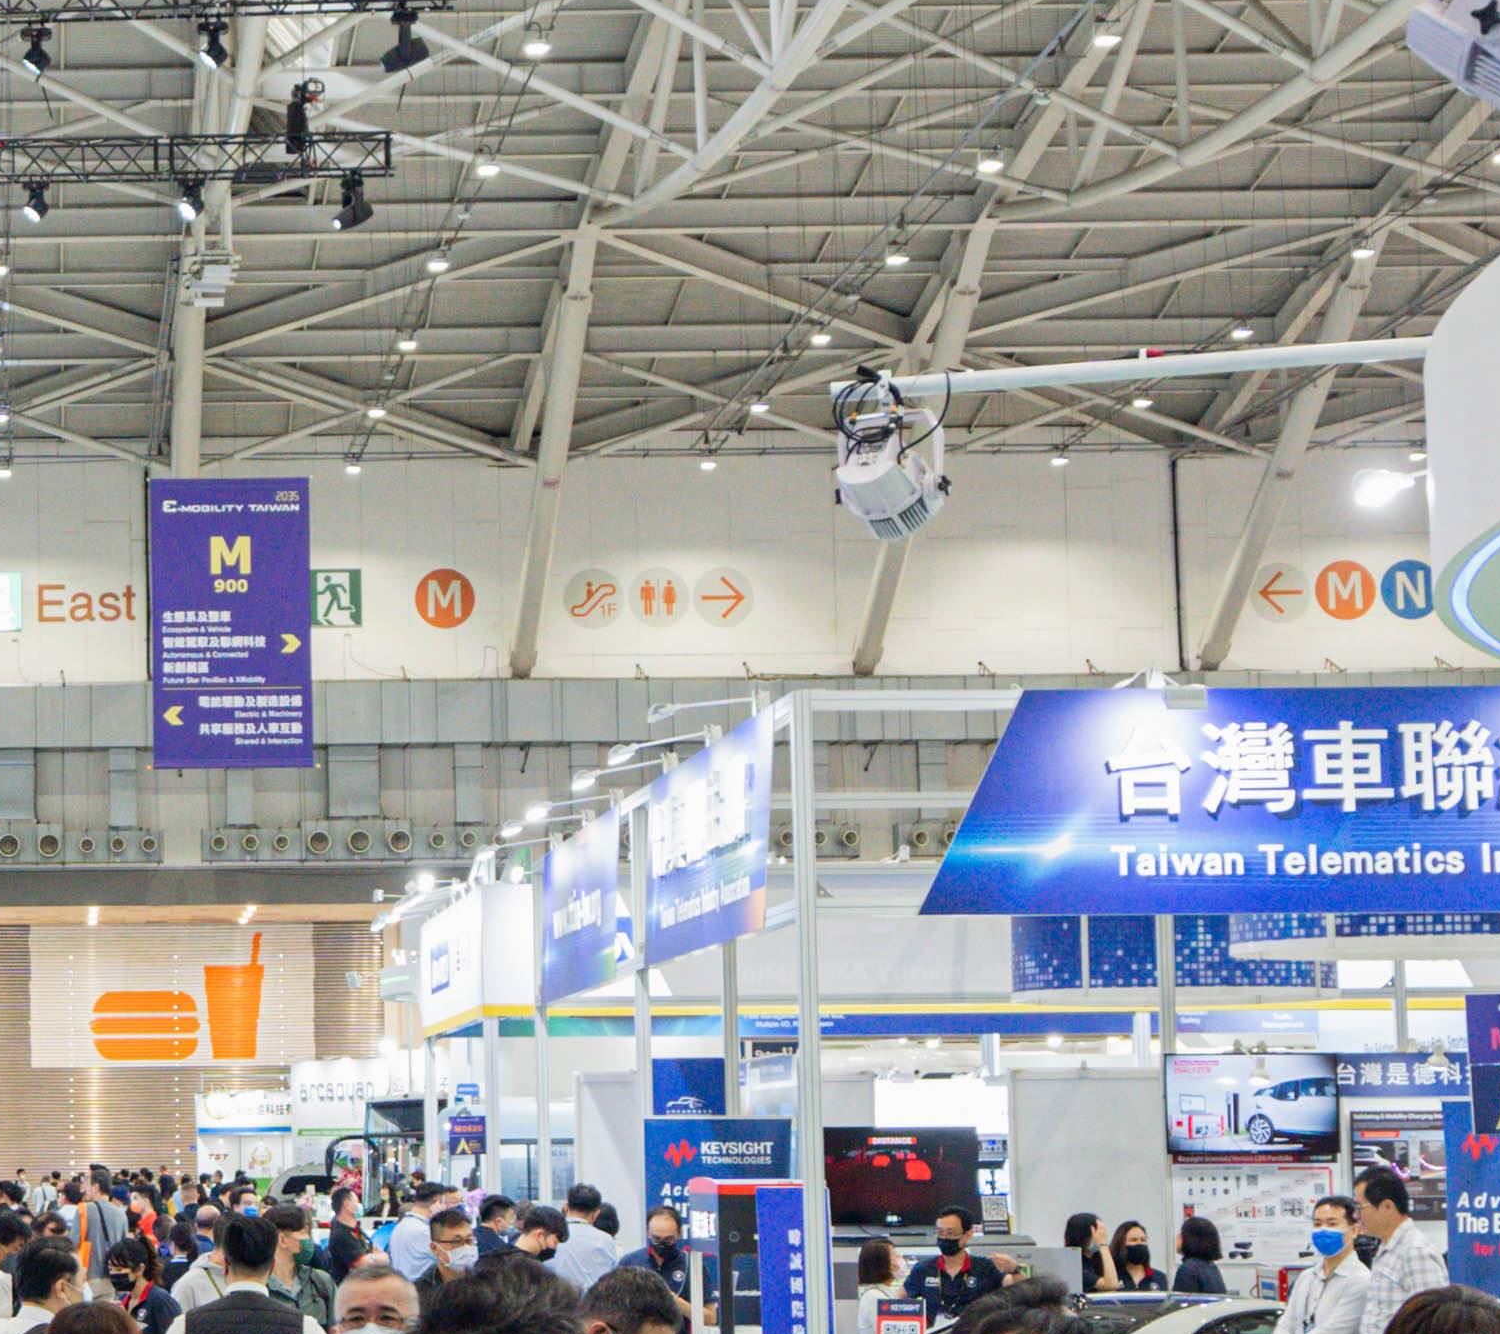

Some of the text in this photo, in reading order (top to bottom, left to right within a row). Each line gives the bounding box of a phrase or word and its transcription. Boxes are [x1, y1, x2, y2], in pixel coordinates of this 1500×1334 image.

[248, 503, 300, 512] TAIWAN
[210, 535, 251, 575] M
[214, 579, 248, 593] 900
[1326, 569, 1427, 609] M N
[37, 584, 136, 622] East
[427, 580, 462, 619] M
[601, 603, 618, 617] 1F
[1111, 844, 1245, 876] Taiwan
[1264, 843, 1465, 875] Telematics
[700, 1141, 774, 1154] KEYSIGHT
[700, 1155, 772, 1165] TECHNOLOGIES
[1456, 1212, 1489, 1234] The
[1473, 1242, 1495, 1257] for
